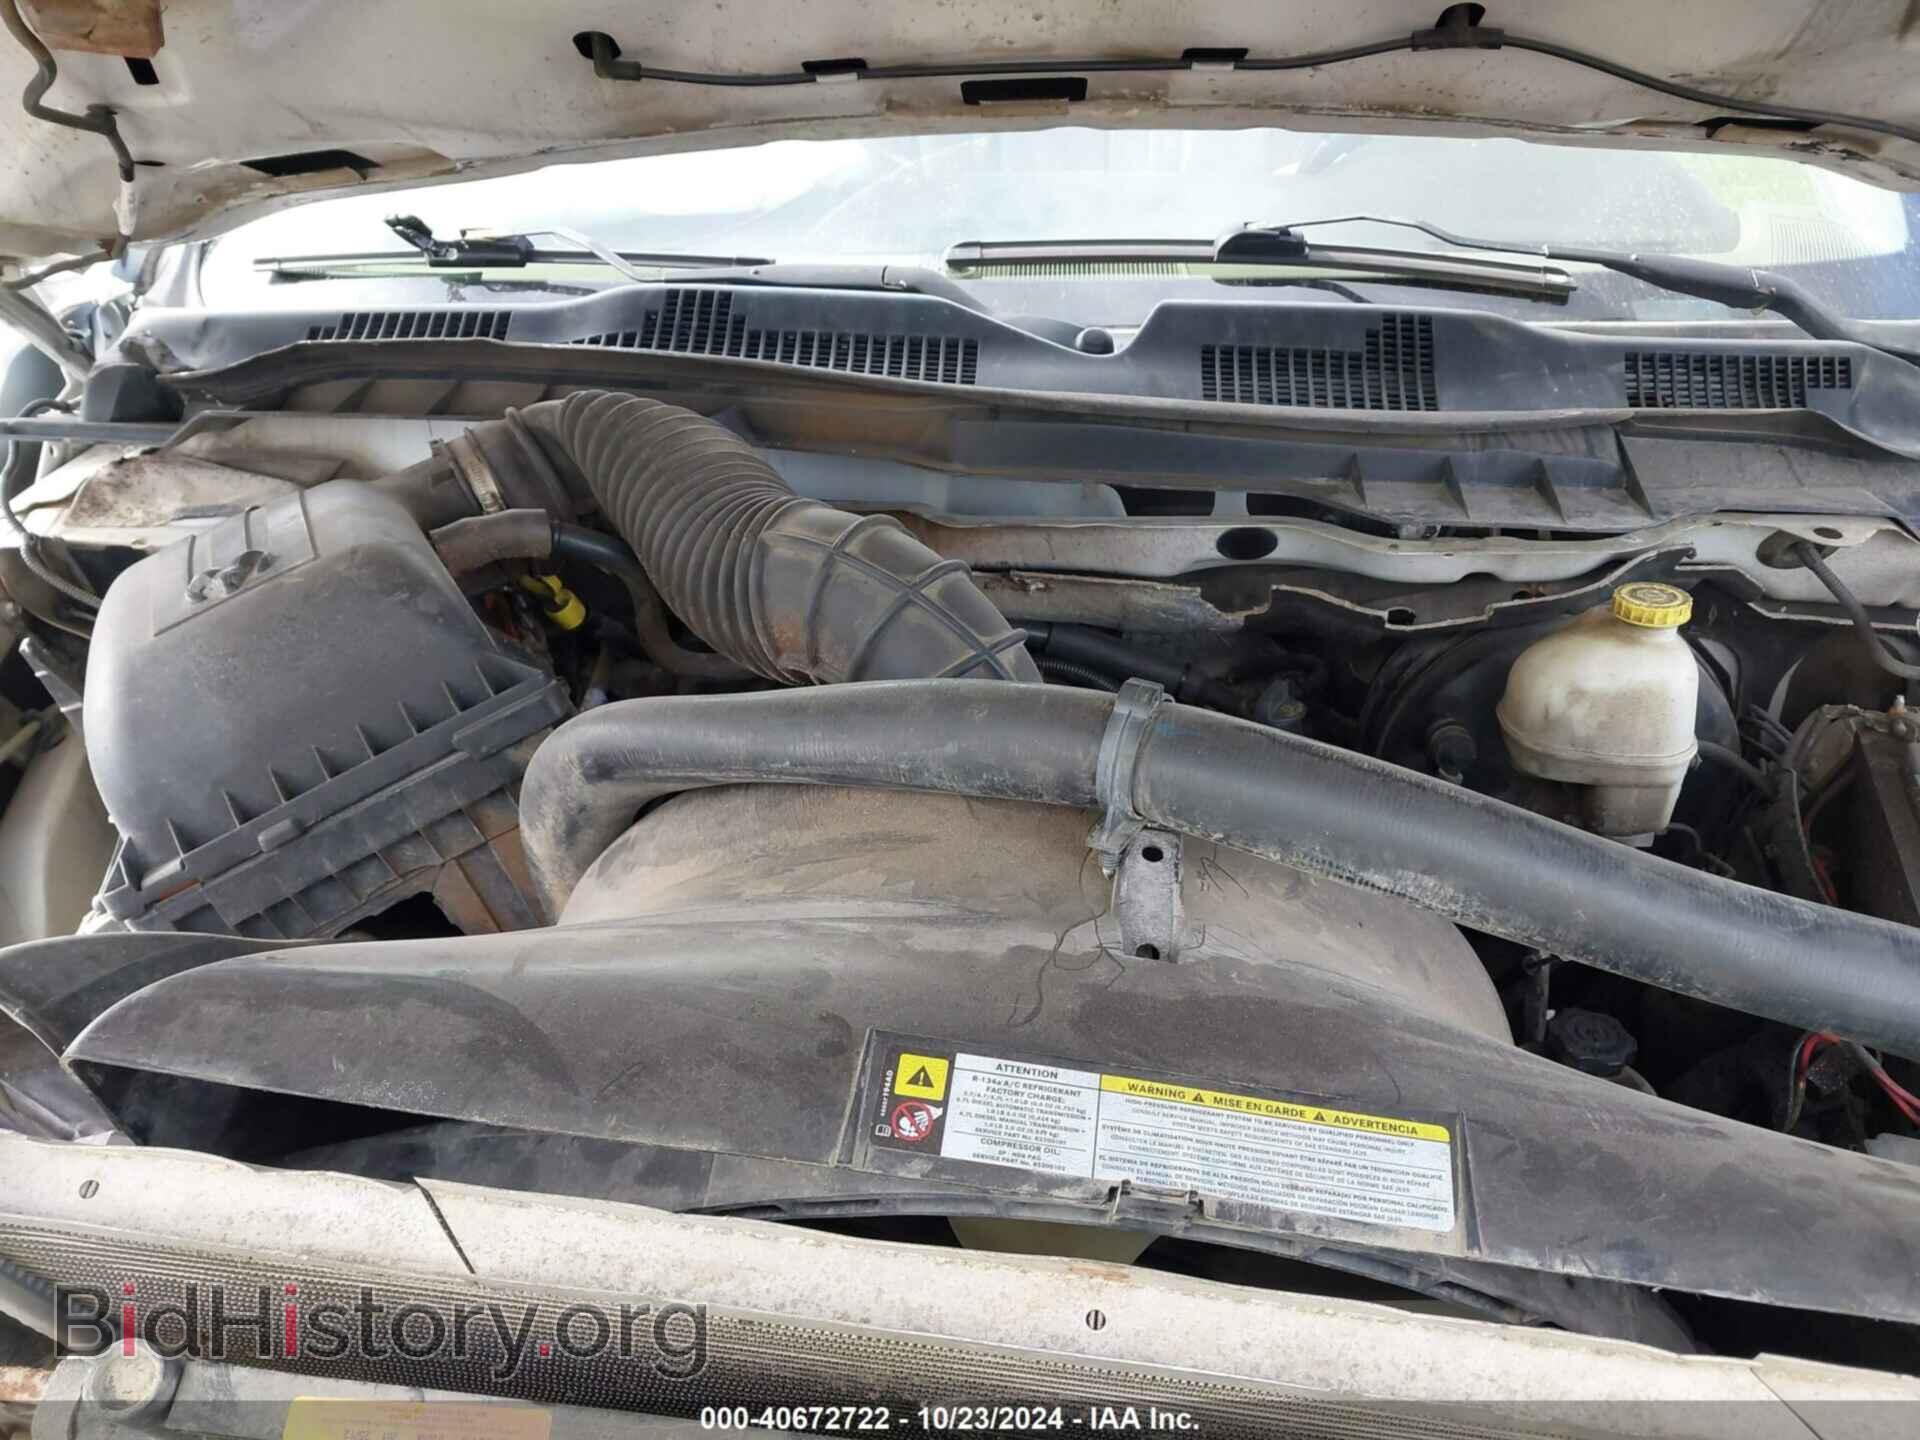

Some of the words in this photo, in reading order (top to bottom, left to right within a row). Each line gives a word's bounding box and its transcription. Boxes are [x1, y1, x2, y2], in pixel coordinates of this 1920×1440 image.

[995, 1062, 1058, 1080] ATTENTION
[986, 1085, 1024, 1097] FACTORY
[1026, 1092, 1064, 1104] CHARGE:
[1003, 1079, 1021, 1088] A/C
[1022, 1082, 1081, 1098] REFRIGERANT
[1127, 1082, 1186, 1100] WARNING
[1213, 1095, 1242, 1108] MISE
[1246, 1100, 1261, 1111] EN
[1265, 1103, 1306, 1118] GARDE
[1334, 1113, 1417, 1136] ADVERTENCIA
[979, 1137, 1041, 1152] COMPRESSOR
